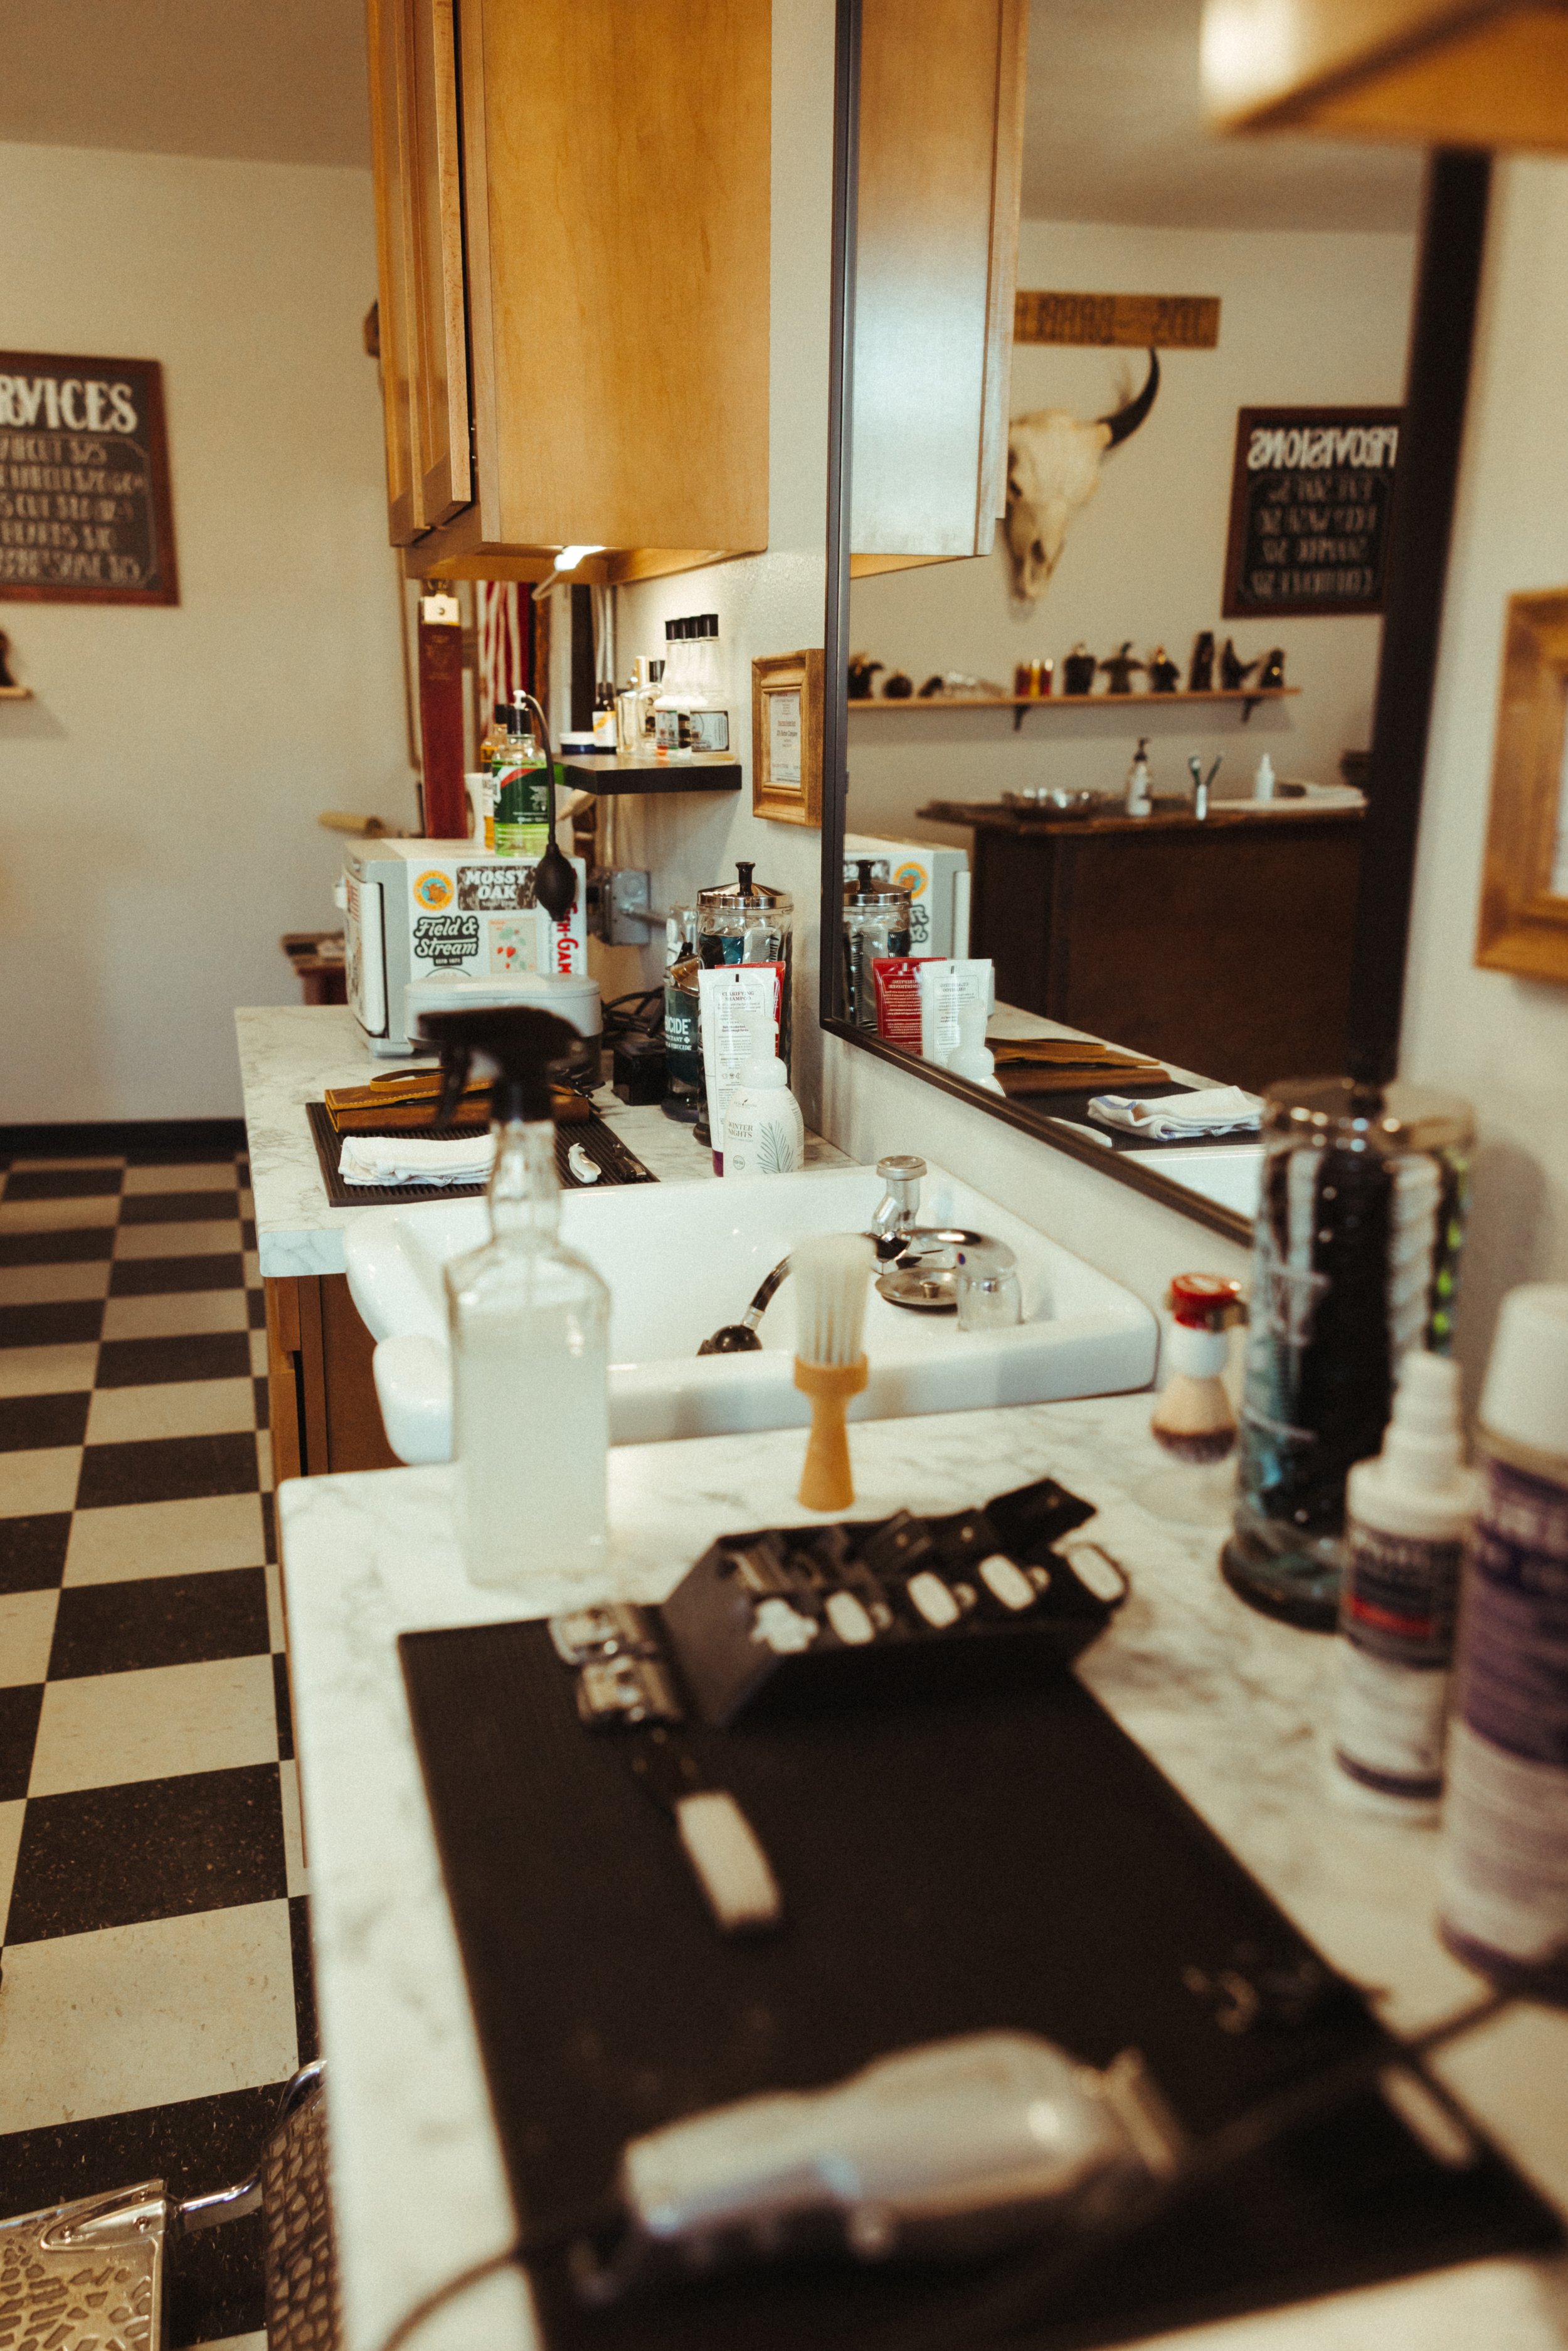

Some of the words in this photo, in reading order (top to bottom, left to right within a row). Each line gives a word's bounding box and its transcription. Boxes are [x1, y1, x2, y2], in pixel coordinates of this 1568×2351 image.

[465, 869, 528, 885] MOSSY
[477, 884, 517, 900] OAK
[415, 917, 462, 937] Field
[462, 916, 478, 935] &
[416, 938, 477, 957] Stream
[728, 1122, 753, 1131] WINTER
[728, 1128, 753, 1138] NIGHTS
